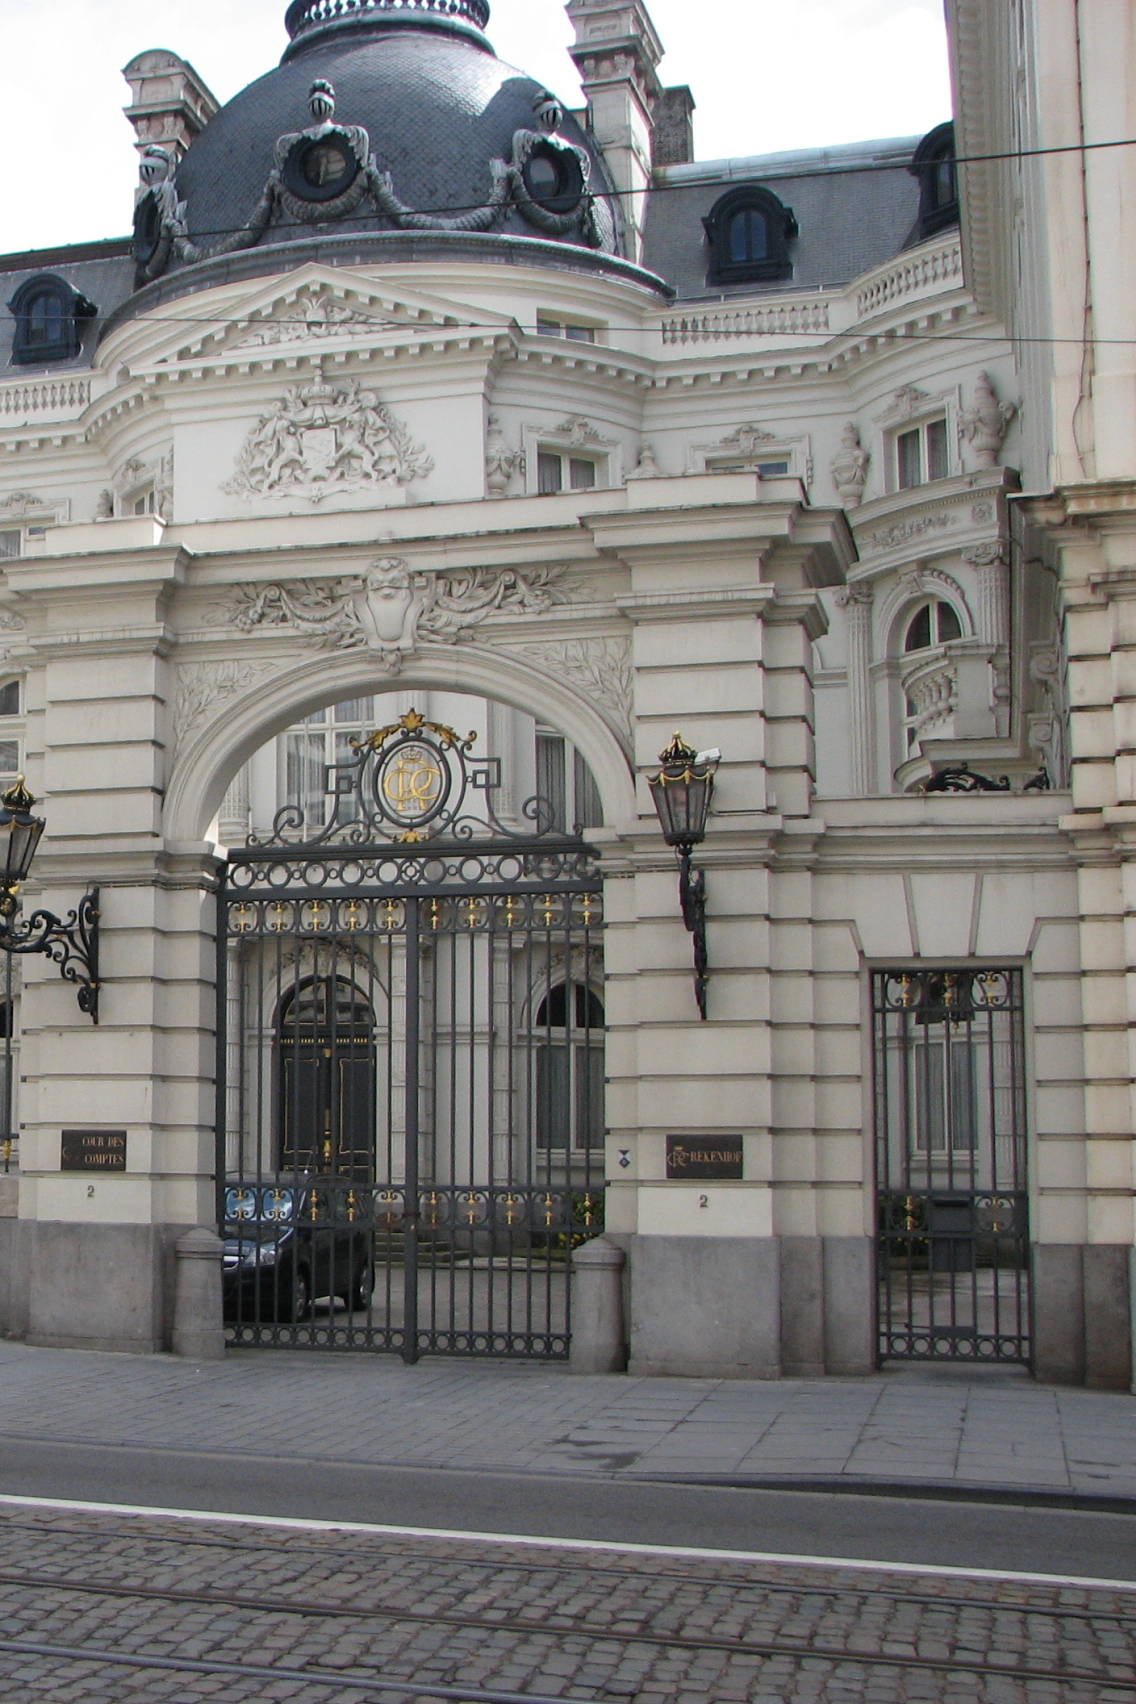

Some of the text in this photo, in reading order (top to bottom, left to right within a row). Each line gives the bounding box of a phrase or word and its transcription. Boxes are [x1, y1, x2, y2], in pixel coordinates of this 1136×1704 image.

[82, 1136, 124, 1147] COUR DES
[84, 1153, 124, 1165] COMPTES
[690, 1150, 742, 1163] REKENHOF
[86, 1184, 95, 1198] 2
[698, 1194, 709, 1208] 2
